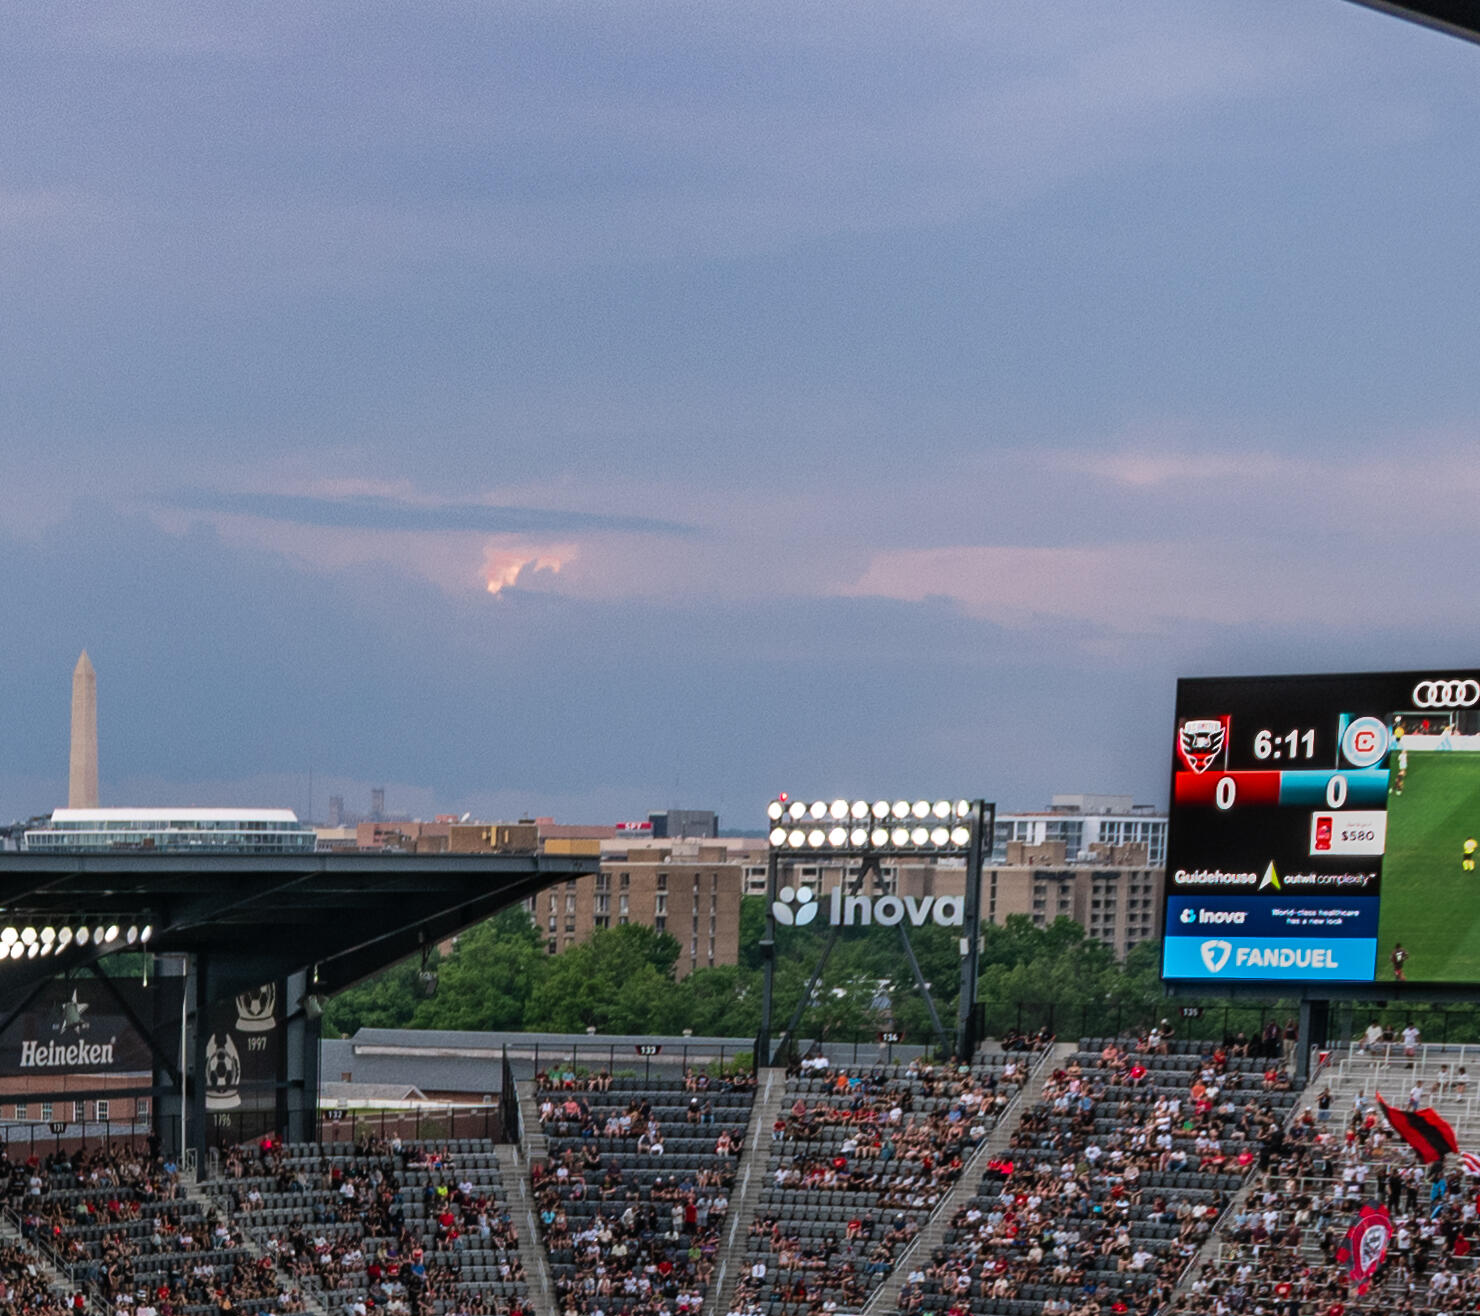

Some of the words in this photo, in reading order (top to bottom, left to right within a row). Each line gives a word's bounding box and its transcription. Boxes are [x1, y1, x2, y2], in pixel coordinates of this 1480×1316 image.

[1254, 729, 1315, 760] 6:11
[1216, 777, 1237, 809] 0
[1325, 775, 1348, 808] 0
[1341, 830, 1376, 842] $580
[1174, 869, 1257, 886] Guidehouse
[830, 886, 965, 926] Inova
[1199, 909, 1245, 925] Inova
[1236, 947, 1339, 968] FANDUEL
[19, 1039, 115, 1068] Heineken
